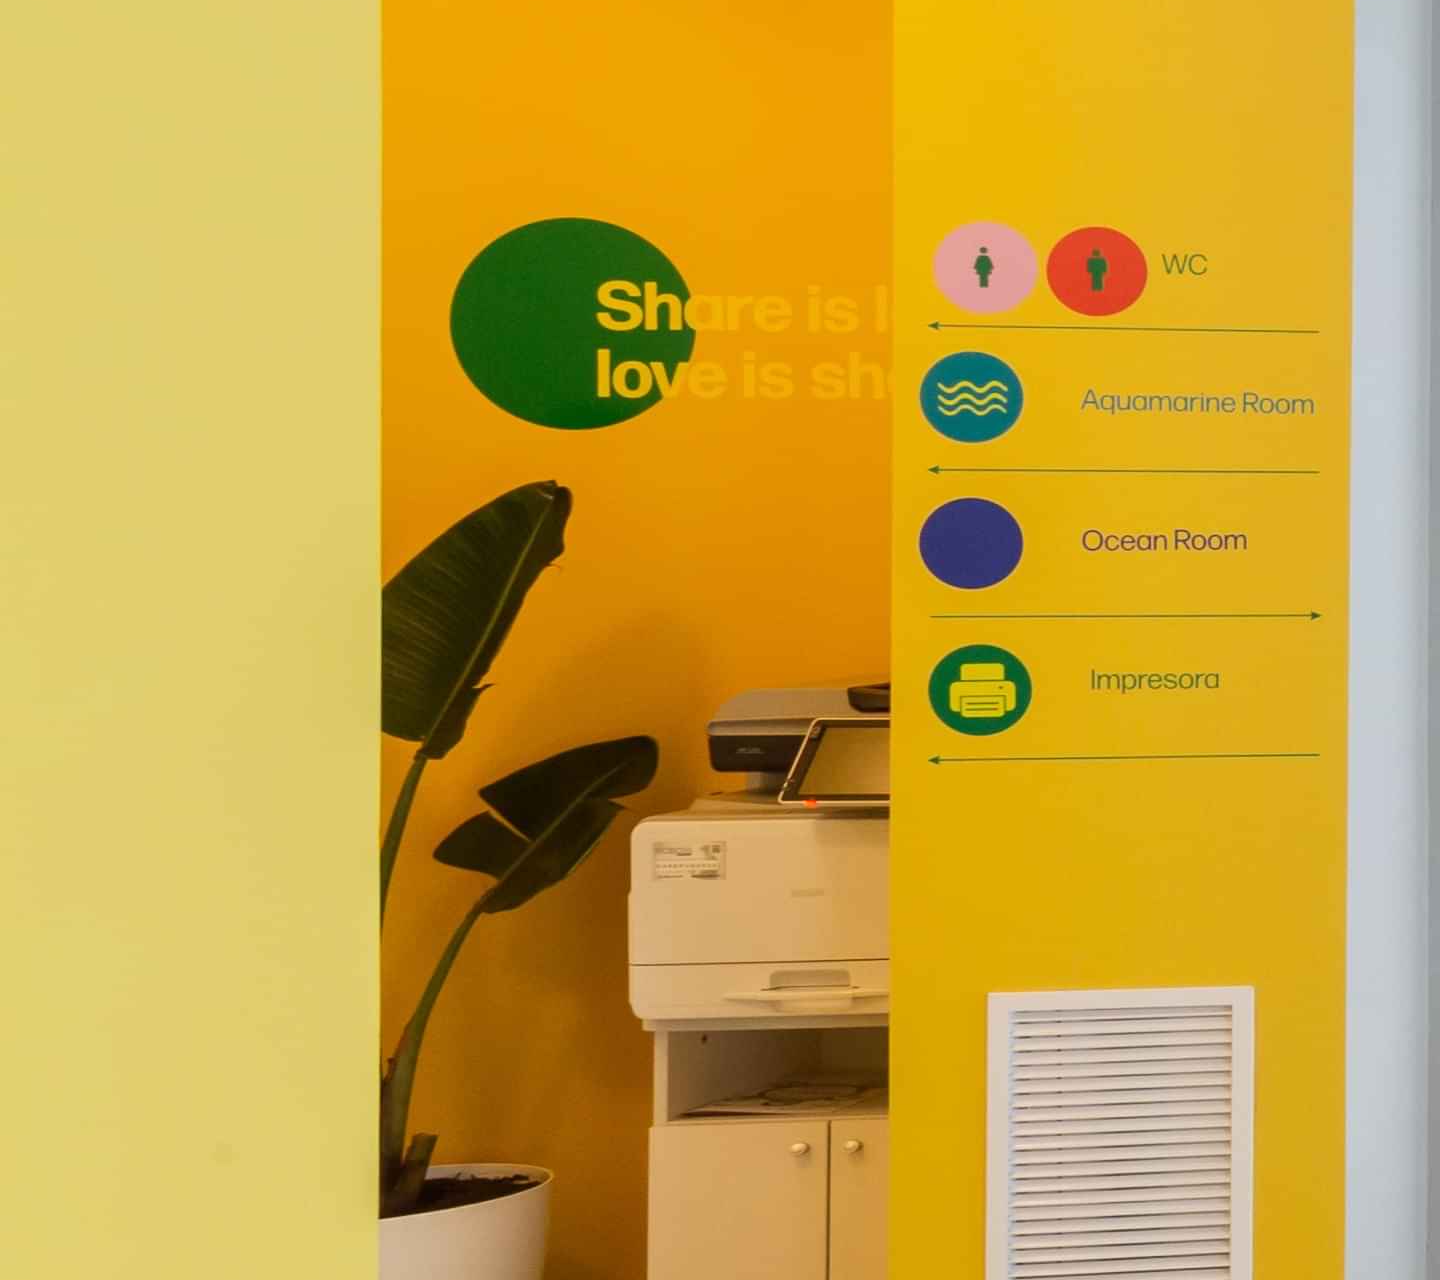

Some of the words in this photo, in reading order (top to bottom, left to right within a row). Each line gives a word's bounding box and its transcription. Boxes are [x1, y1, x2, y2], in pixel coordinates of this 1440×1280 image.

[1161, 253, 1208, 276] WC
[596, 280, 794, 333] Share
[807, 284, 860, 333] is
[596, 348, 729, 399] love
[743, 351, 795, 400] is
[1080, 388, 1236, 415] Aquamarine
[1242, 391, 1316, 415] Room
[1081, 529, 1168, 552] Ocean
[1173, 528, 1248, 551] Room
[1090, 669, 1220, 694] Impresora
